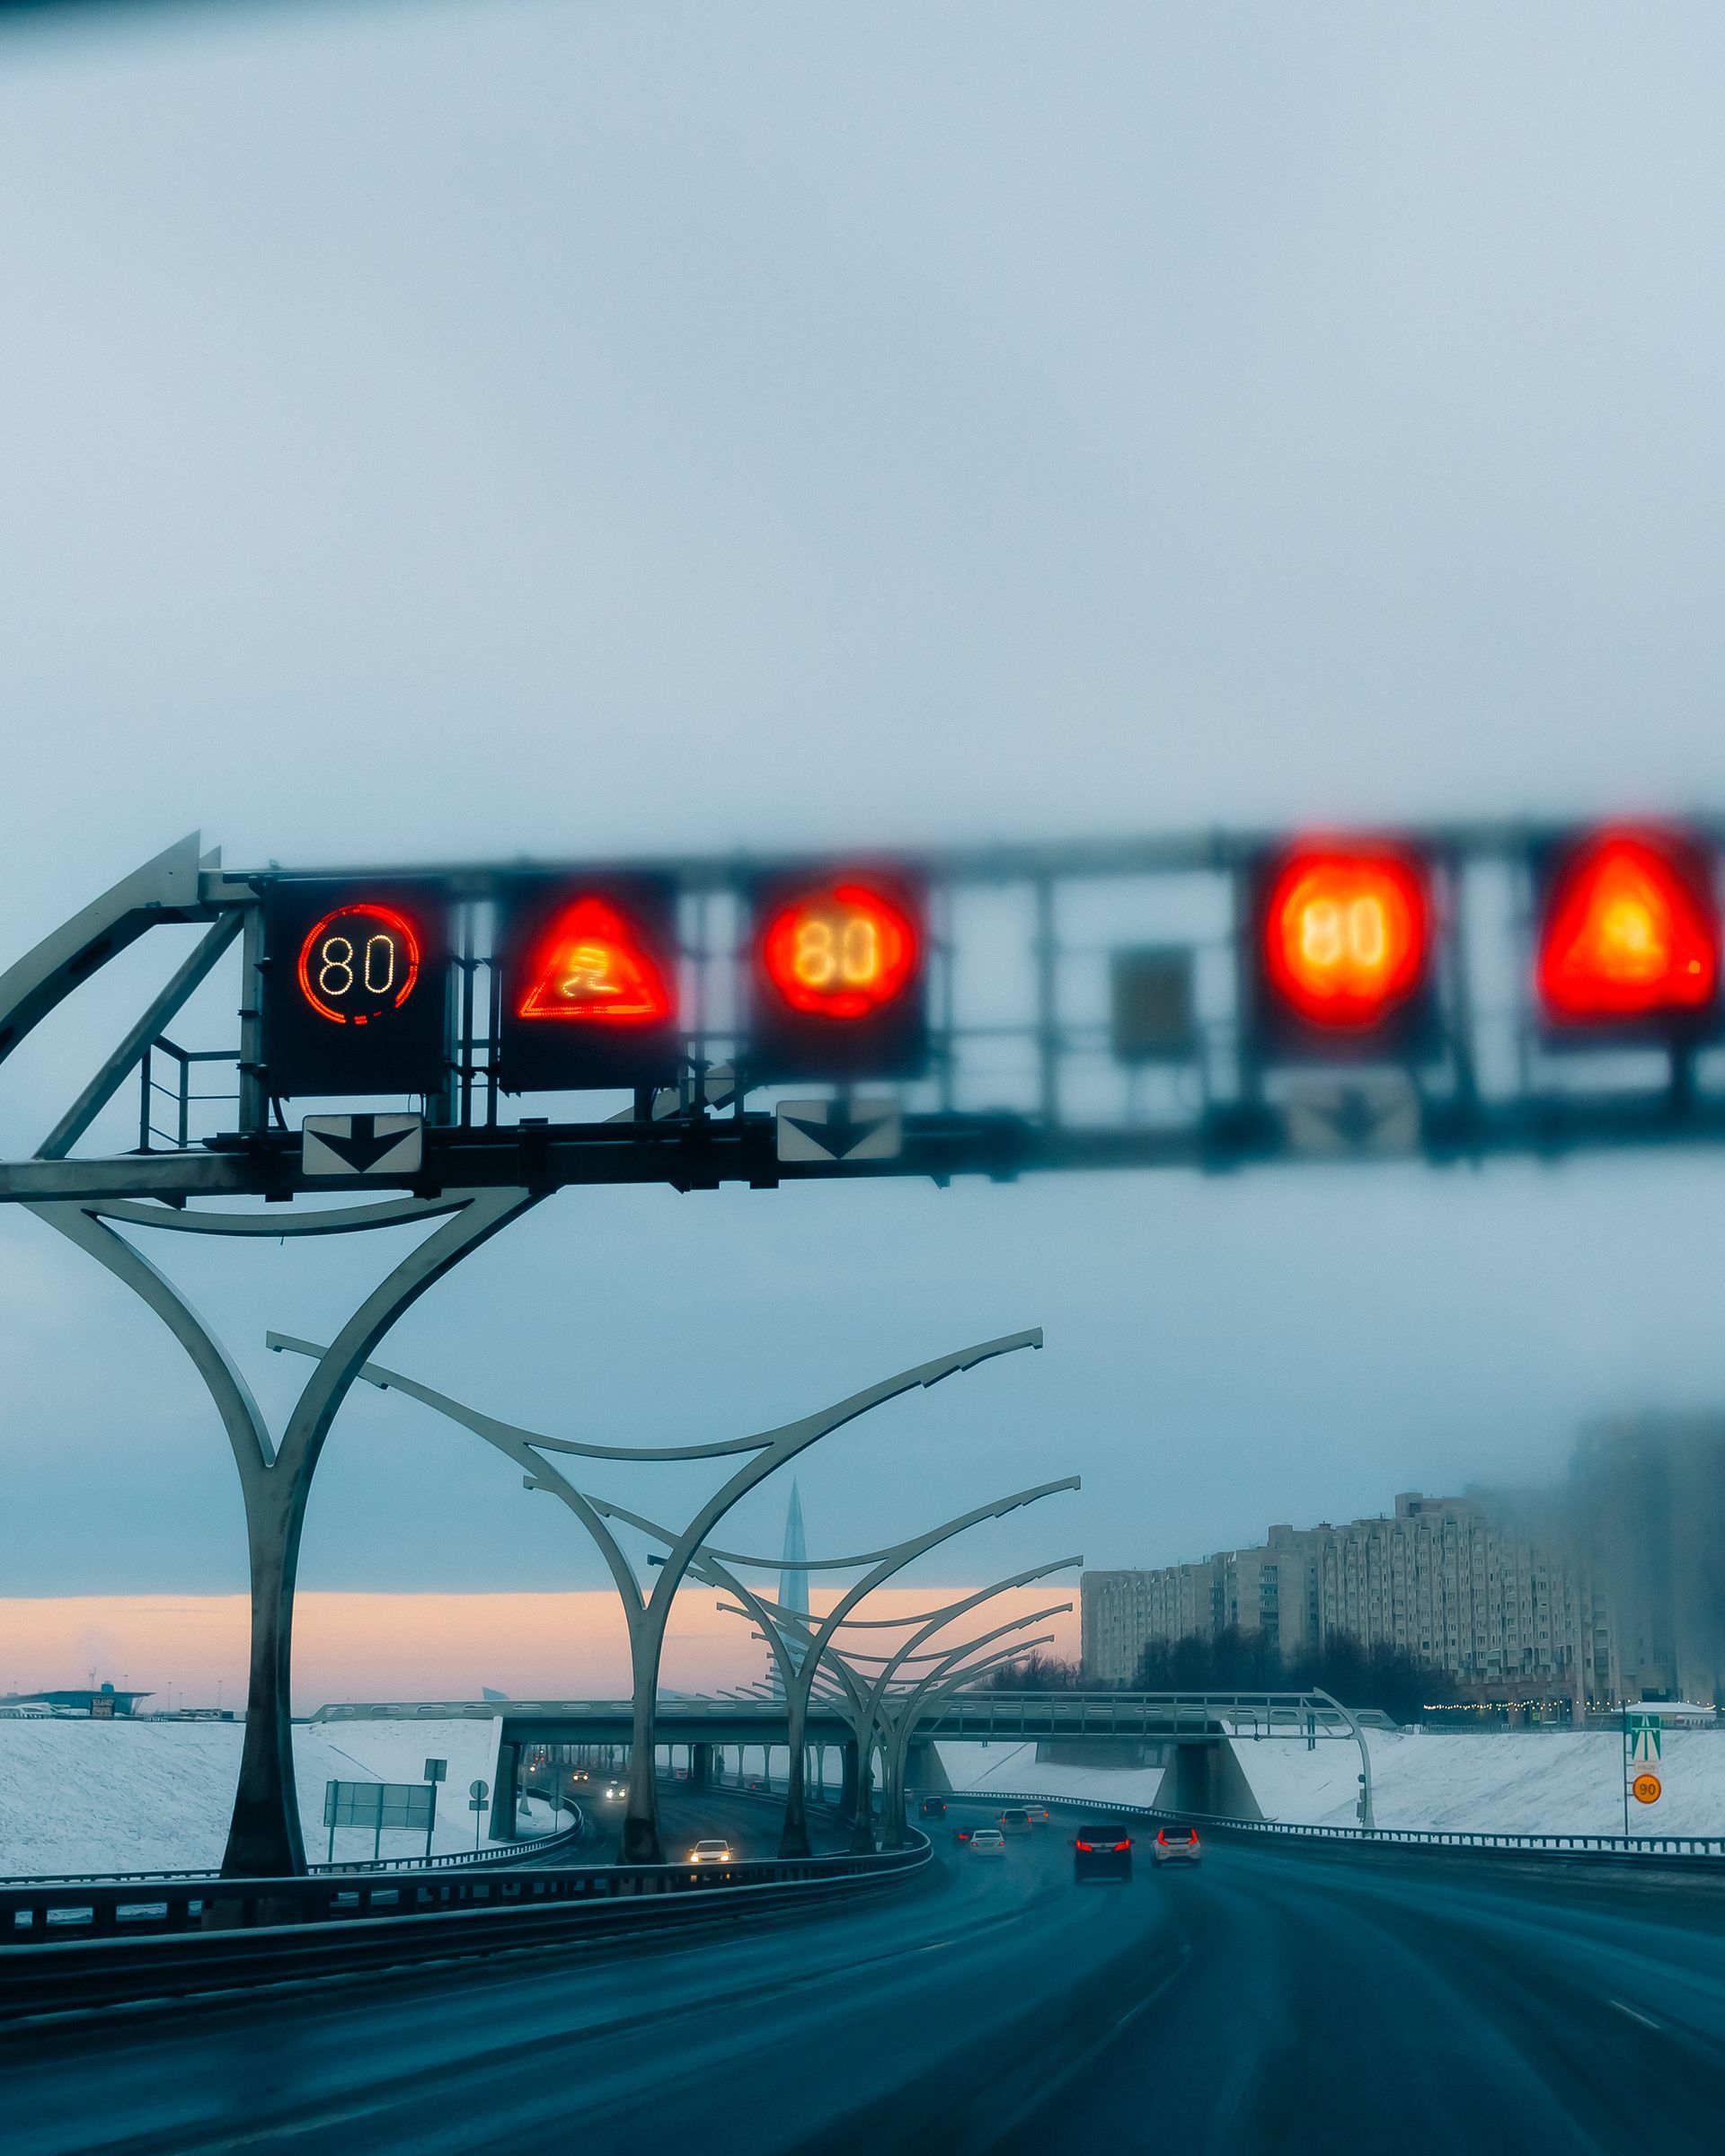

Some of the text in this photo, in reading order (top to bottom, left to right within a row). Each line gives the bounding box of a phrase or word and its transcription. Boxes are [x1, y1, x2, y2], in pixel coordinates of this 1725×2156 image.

[795, 919, 876, 985] 80
[1302, 897, 1386, 966] 80
[319, 935, 394, 995] 80
[1640, 1783, 1656, 1796] 90
